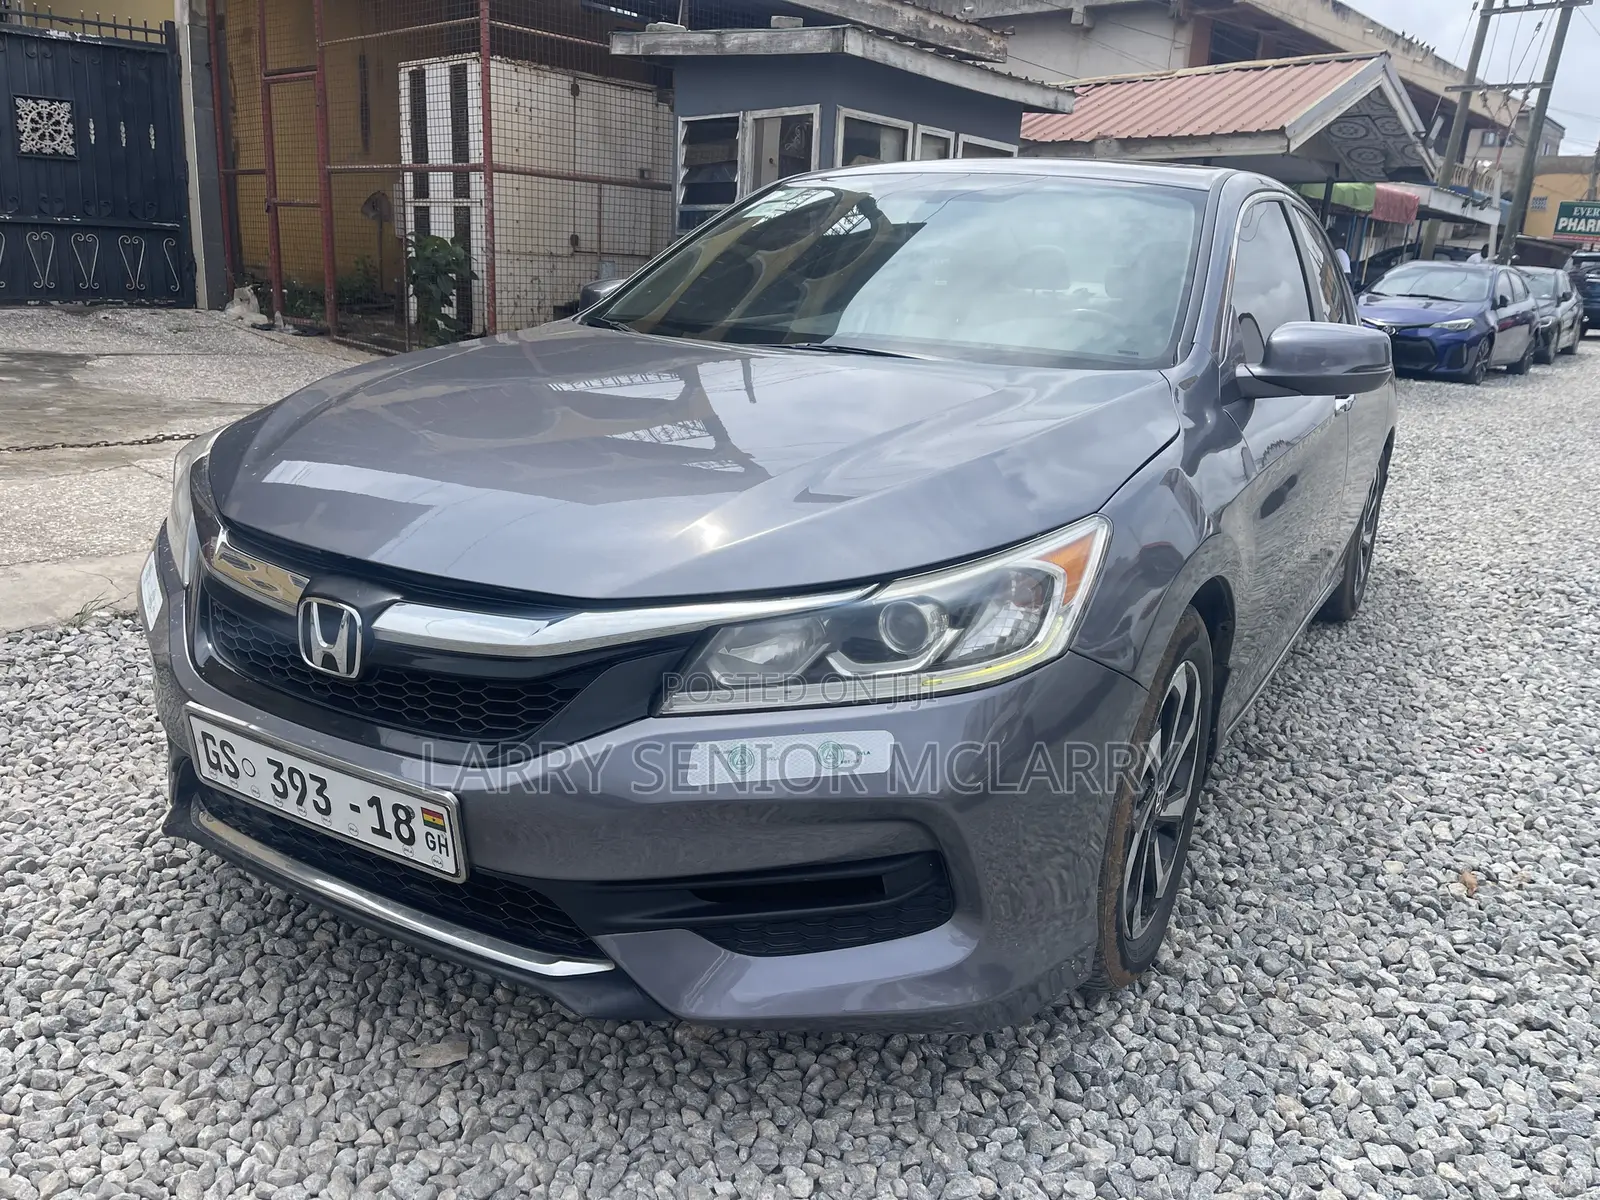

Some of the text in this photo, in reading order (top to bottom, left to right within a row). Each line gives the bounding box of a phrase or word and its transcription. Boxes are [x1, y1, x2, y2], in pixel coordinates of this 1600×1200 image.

[201, 730, 240, 779] GS
[266, 757, 332, 816] 393
[425, 831, 450, 857] GH
